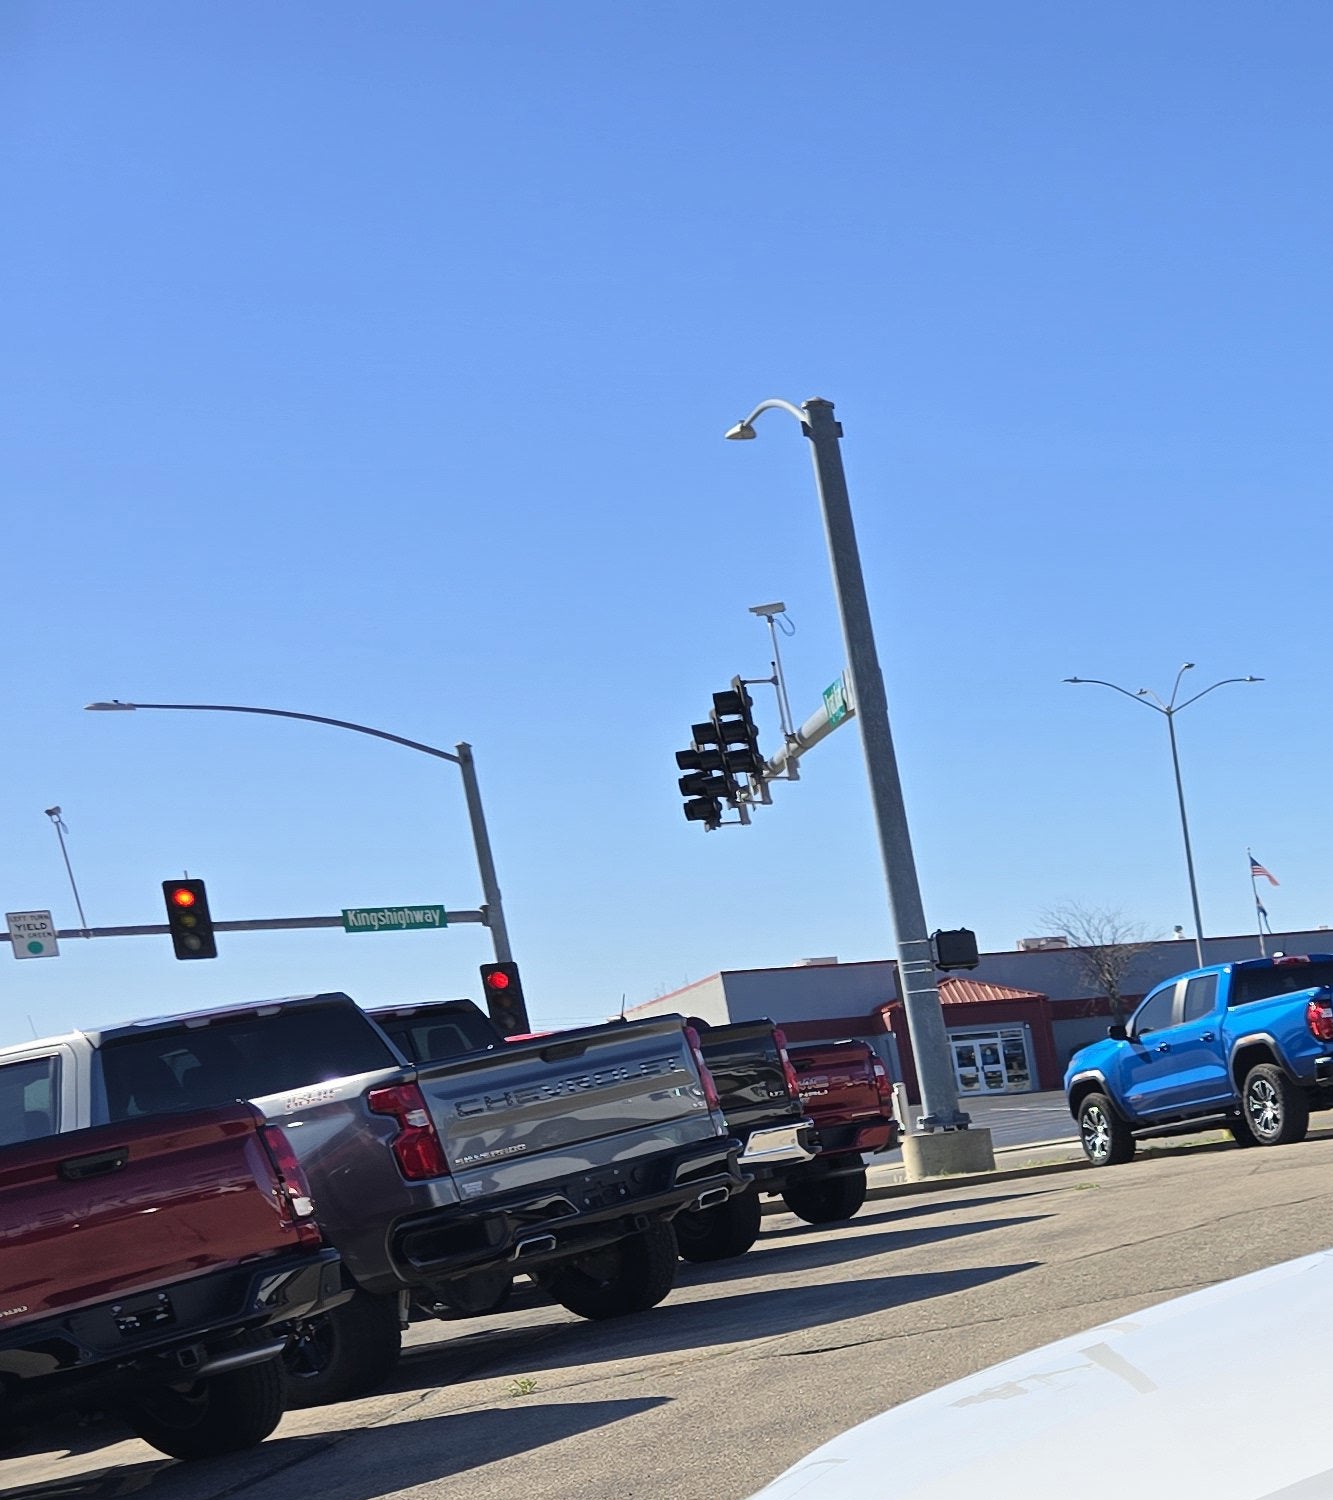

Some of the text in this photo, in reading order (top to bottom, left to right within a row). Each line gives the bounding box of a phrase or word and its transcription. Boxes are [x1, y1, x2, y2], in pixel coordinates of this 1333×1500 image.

[14, 922, 48, 931] YIELD
[346, 907, 441, 930] Kingshighway
[453, 1055, 686, 1118] CHEVROLET
